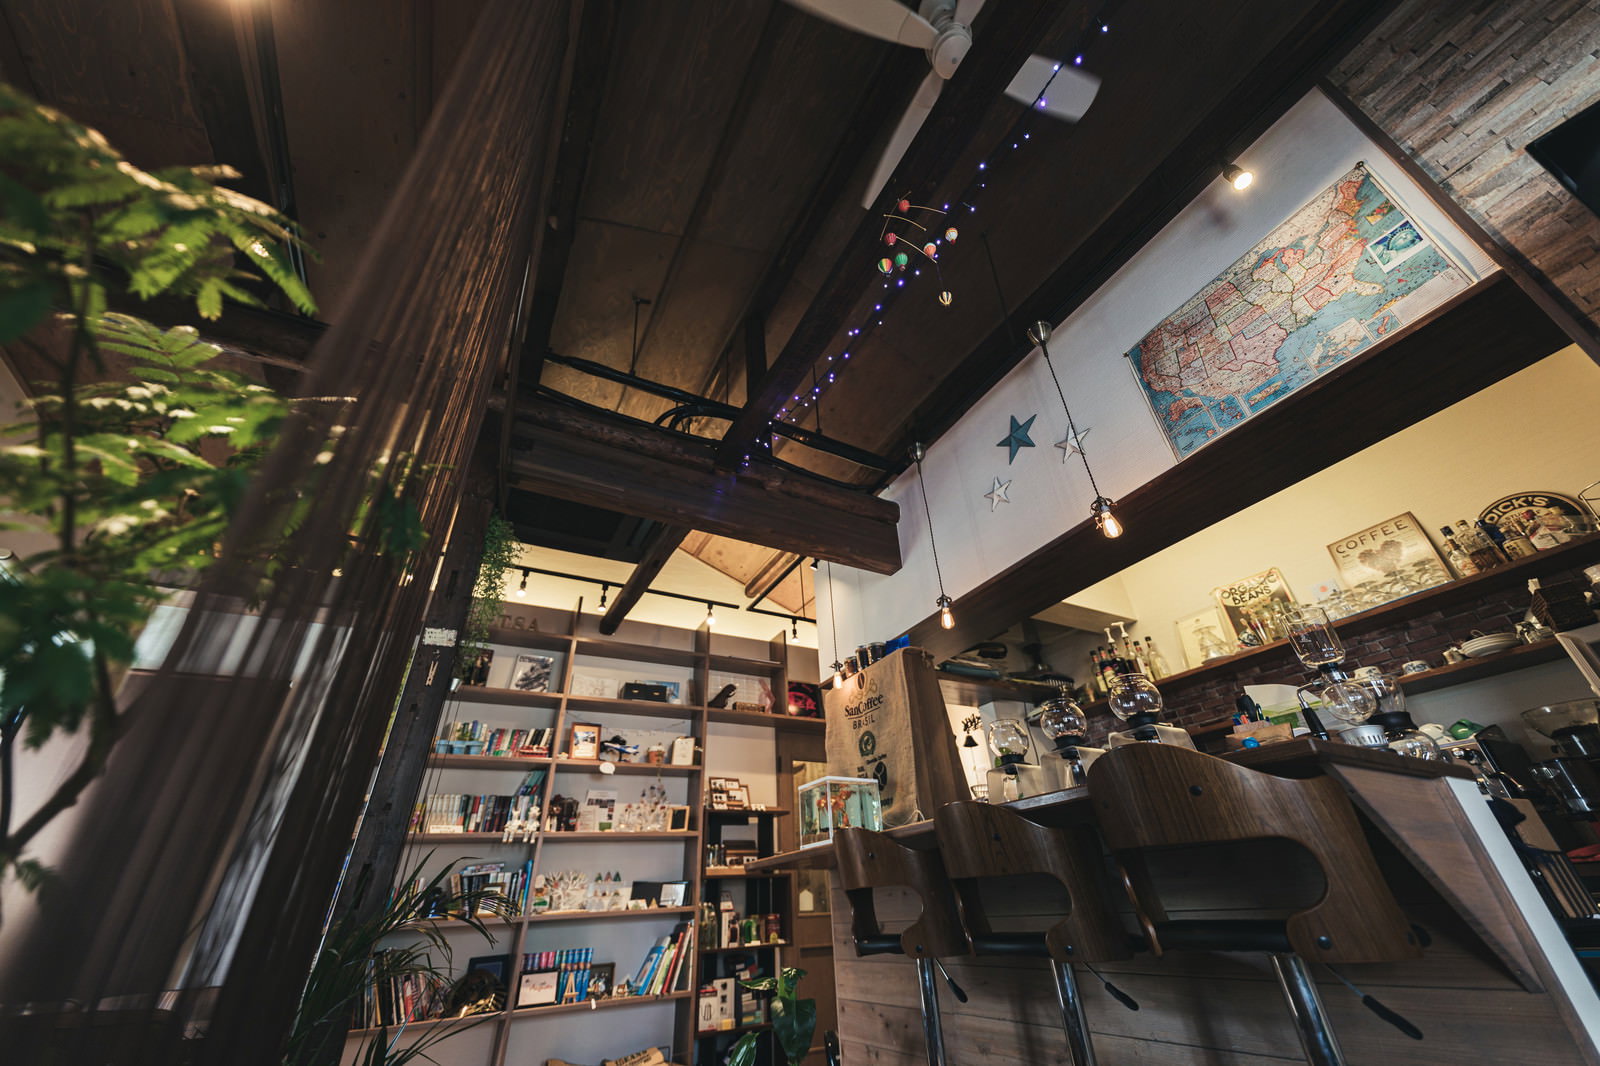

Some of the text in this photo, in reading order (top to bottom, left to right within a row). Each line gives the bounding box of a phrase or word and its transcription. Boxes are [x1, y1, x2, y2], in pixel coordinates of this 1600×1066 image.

[1484, 496, 1549, 525] DICK'S
[1335, 519, 1408, 554] COFFEE
[1232, 585, 1272, 606] BEANS
[844, 694, 884, 718] SanCoffee
